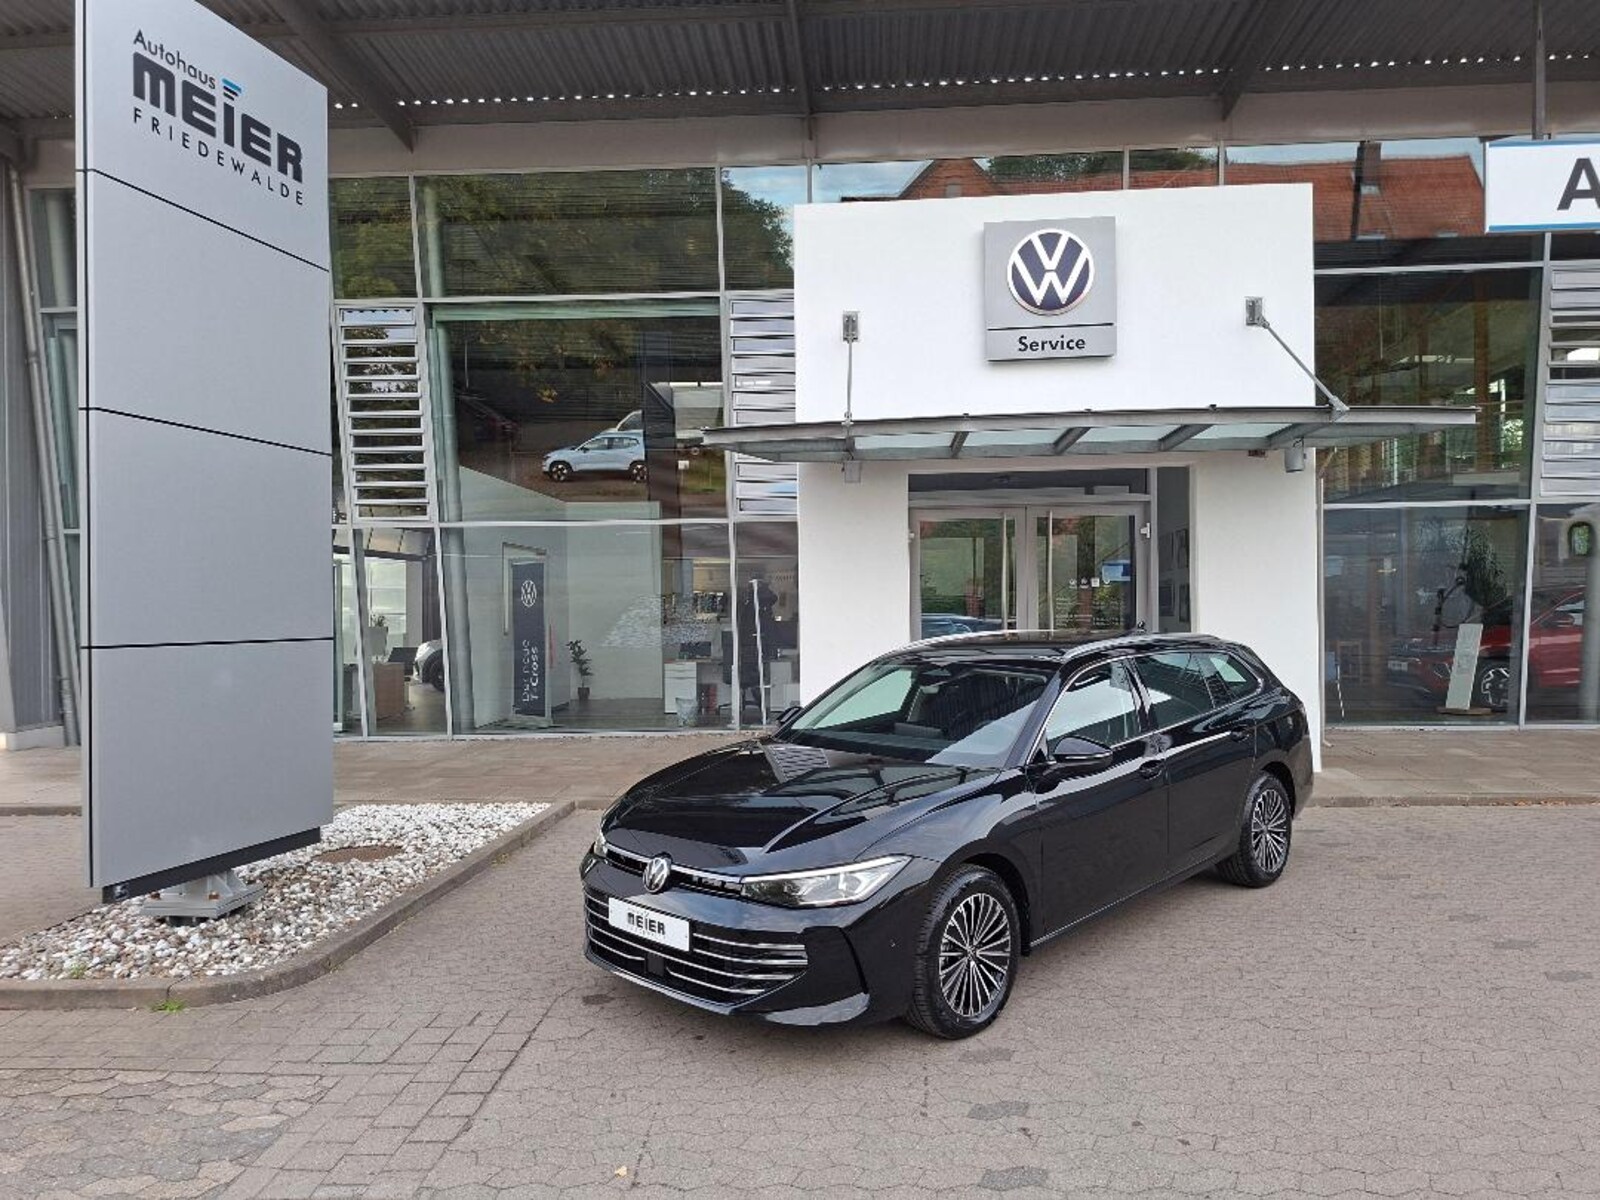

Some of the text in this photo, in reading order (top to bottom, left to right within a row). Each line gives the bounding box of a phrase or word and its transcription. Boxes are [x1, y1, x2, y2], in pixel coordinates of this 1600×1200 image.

[133, 29, 216, 90] Autohaus
[133, 106, 304, 206] FRIEDEWALDE
[1018, 334, 1087, 352] Service
